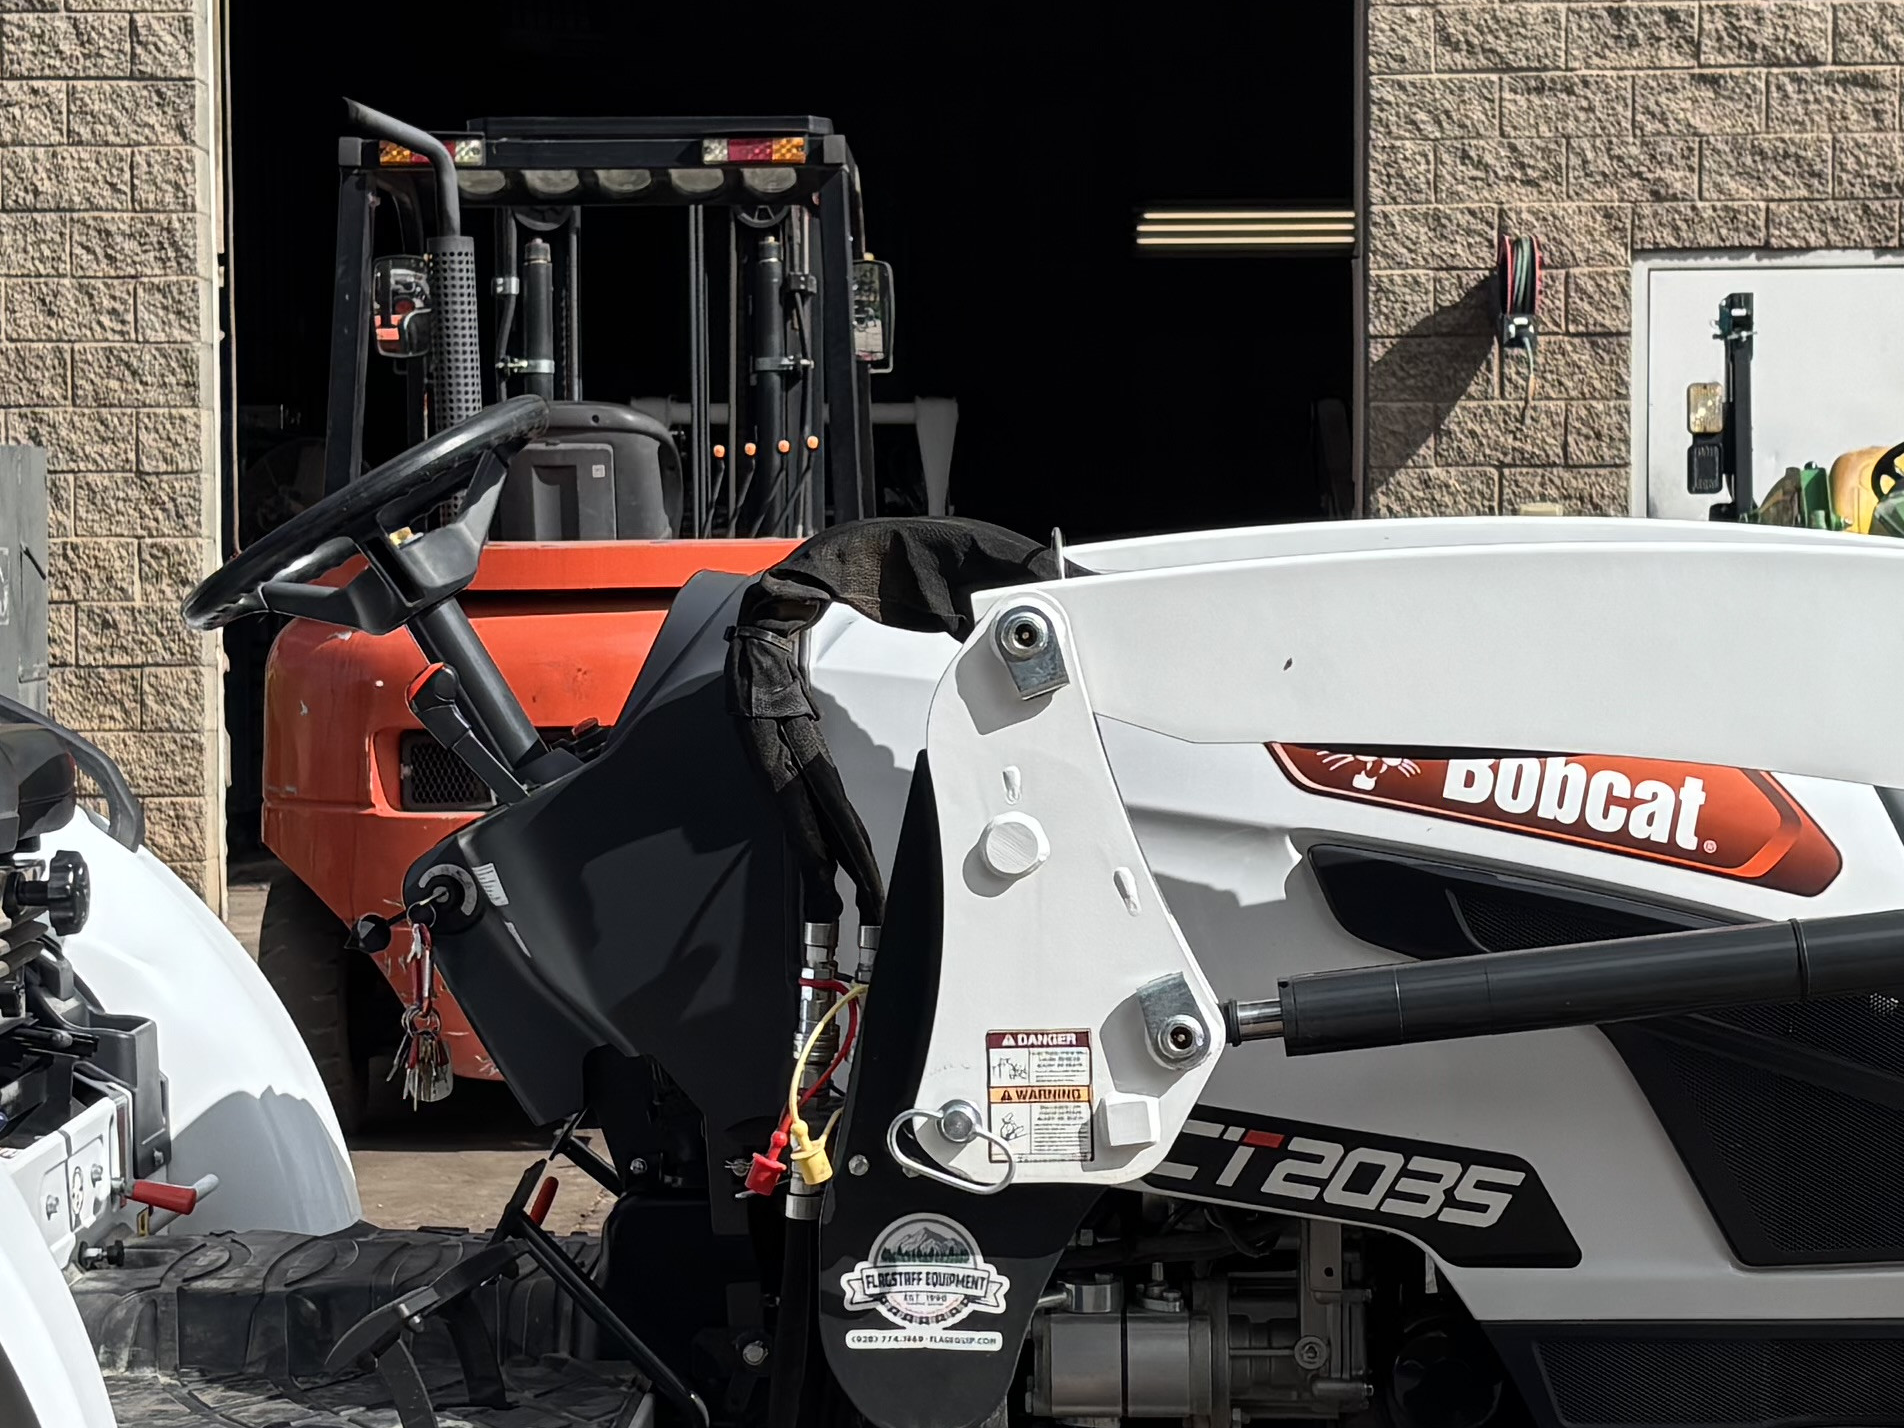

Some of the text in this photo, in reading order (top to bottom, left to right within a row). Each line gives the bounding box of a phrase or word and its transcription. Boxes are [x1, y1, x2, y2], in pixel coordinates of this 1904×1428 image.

[1441, 757, 1706, 851] Bobcat
[1017, 1033, 1077, 1046] DANGER
[1015, 1089, 1082, 1100] WARNING
[864, 1271, 987, 1292] FLAGSTAFF EQUIPMENT
